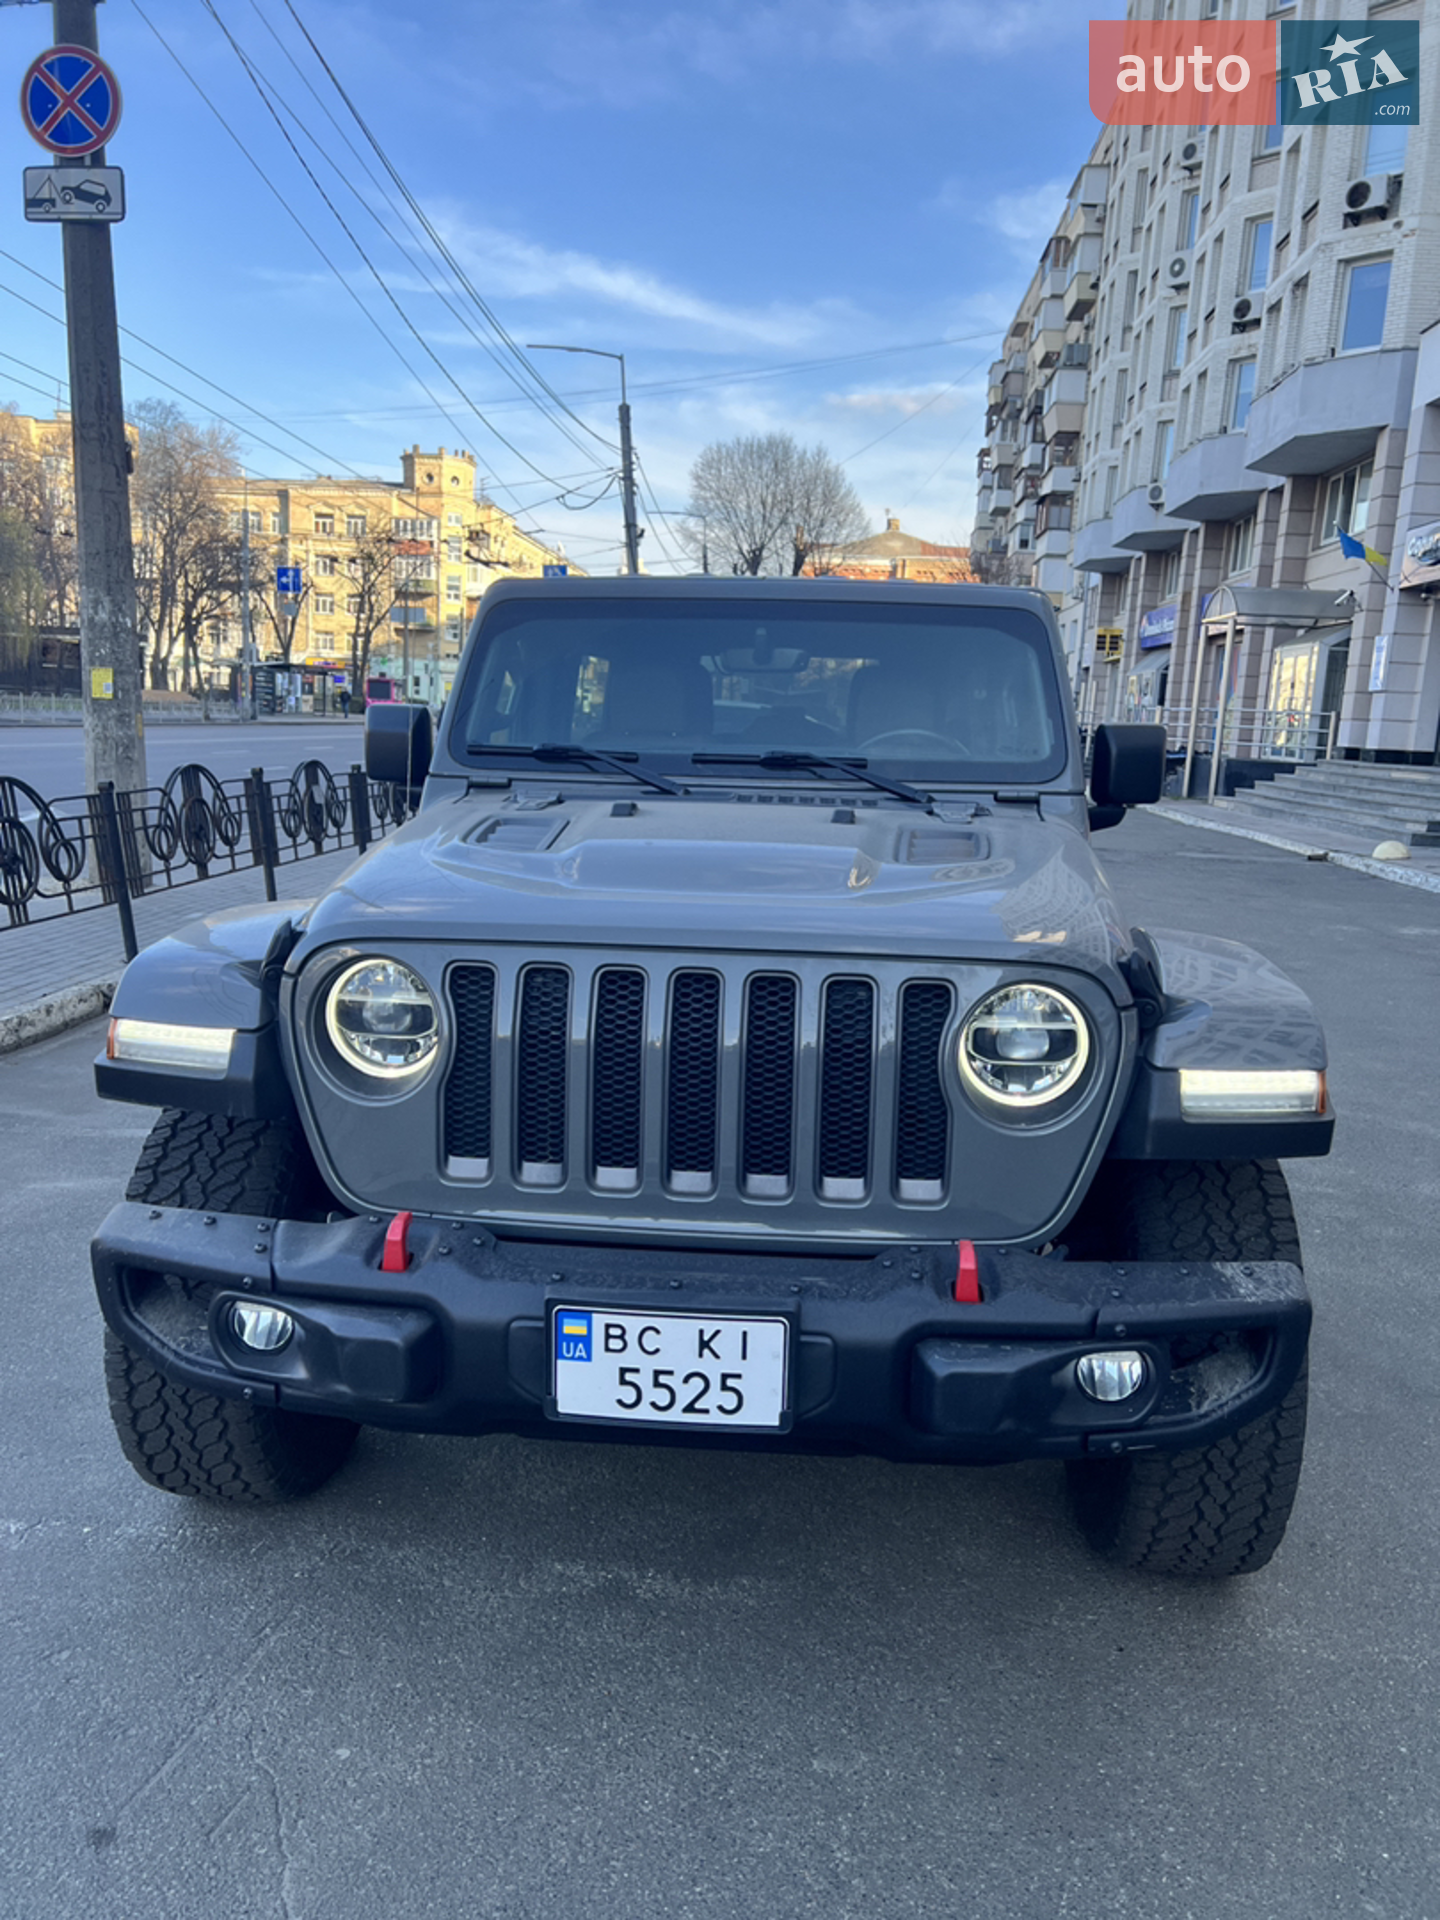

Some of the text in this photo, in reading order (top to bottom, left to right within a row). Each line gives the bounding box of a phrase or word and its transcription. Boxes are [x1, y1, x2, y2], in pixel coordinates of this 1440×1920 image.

[562, 1341, 588, 1359] UA
[604, 1323, 748, 1361] BC KI
[615, 1366, 744, 1415] 5525
